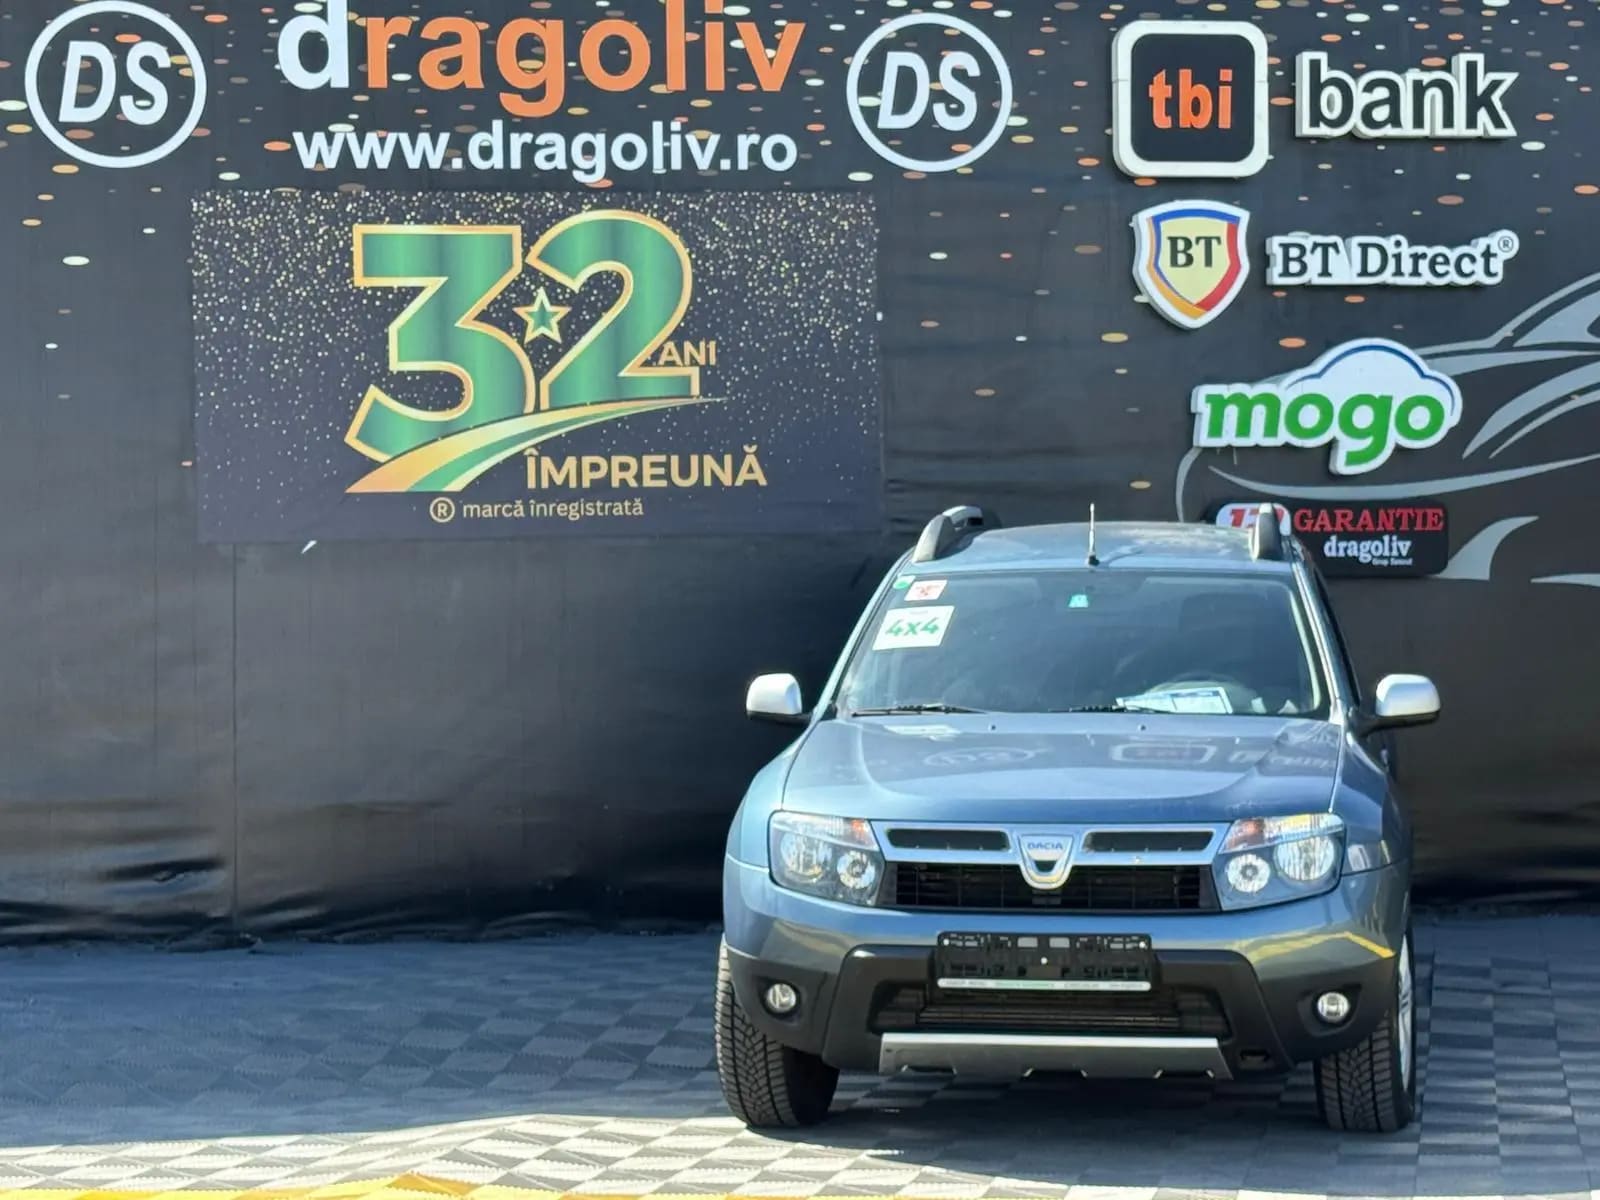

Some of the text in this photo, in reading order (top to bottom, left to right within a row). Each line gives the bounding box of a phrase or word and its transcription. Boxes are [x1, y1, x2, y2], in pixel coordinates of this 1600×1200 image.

[277, 0, 806, 119] dragoliv
[59, 40, 171, 126] DS
[877, 51, 981, 131] DS
[1148, 55, 1512, 134] tbi bank
[293, 120, 799, 184] www.dragoliv.ro
[1167, 235, 1222, 269] BT
[1278, 242, 1340, 278] BT
[345, 208, 700, 464] 32
[657, 339, 718, 367] ANI
[1205, 392, 1446, 467] mogo
[524, 444, 768, 489] ÎMPREUNĂ
[462, 499, 525, 518] marcă
[529, 497, 644, 521] înregistrată
[1293, 507, 1445, 532] GARANTIE
[1323, 534, 1413, 564] dragoliv
[884, 617, 941, 638] 4x4
[1027, 842, 1063, 850] DACIA
